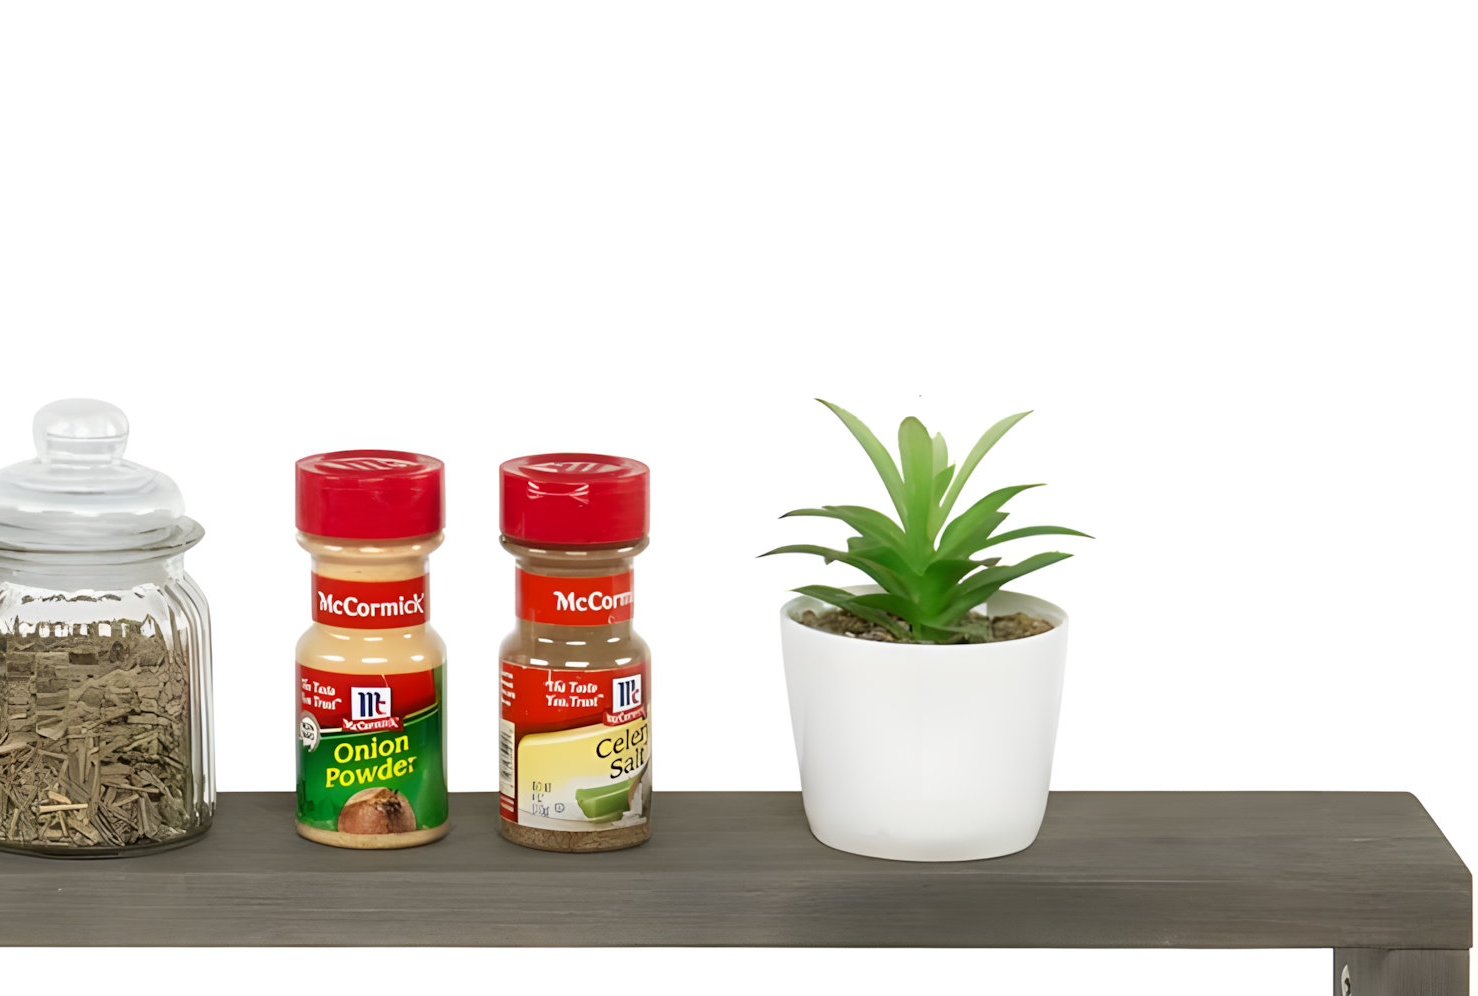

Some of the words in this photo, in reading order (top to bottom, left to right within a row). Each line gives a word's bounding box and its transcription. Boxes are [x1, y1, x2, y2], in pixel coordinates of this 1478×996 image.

[318, 590, 425, 617] McCormick
[334, 735, 410, 764] Onion
[325, 756, 418, 788] Powder
